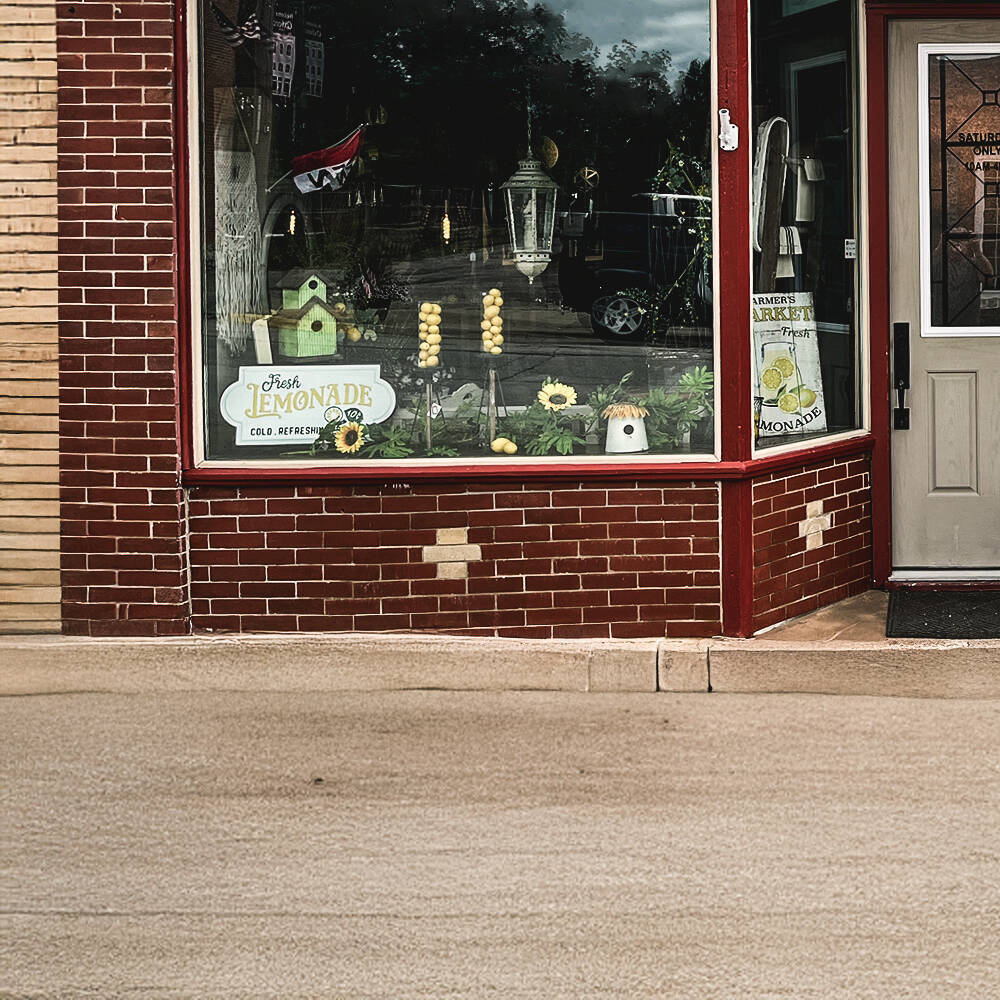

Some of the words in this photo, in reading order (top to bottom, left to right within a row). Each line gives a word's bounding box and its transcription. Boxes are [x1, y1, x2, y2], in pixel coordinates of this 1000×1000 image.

[781, 326, 810, 339] Fresh
[262, 374, 301, 392] Fresh
[244, 383, 372, 420] LEMONADE
